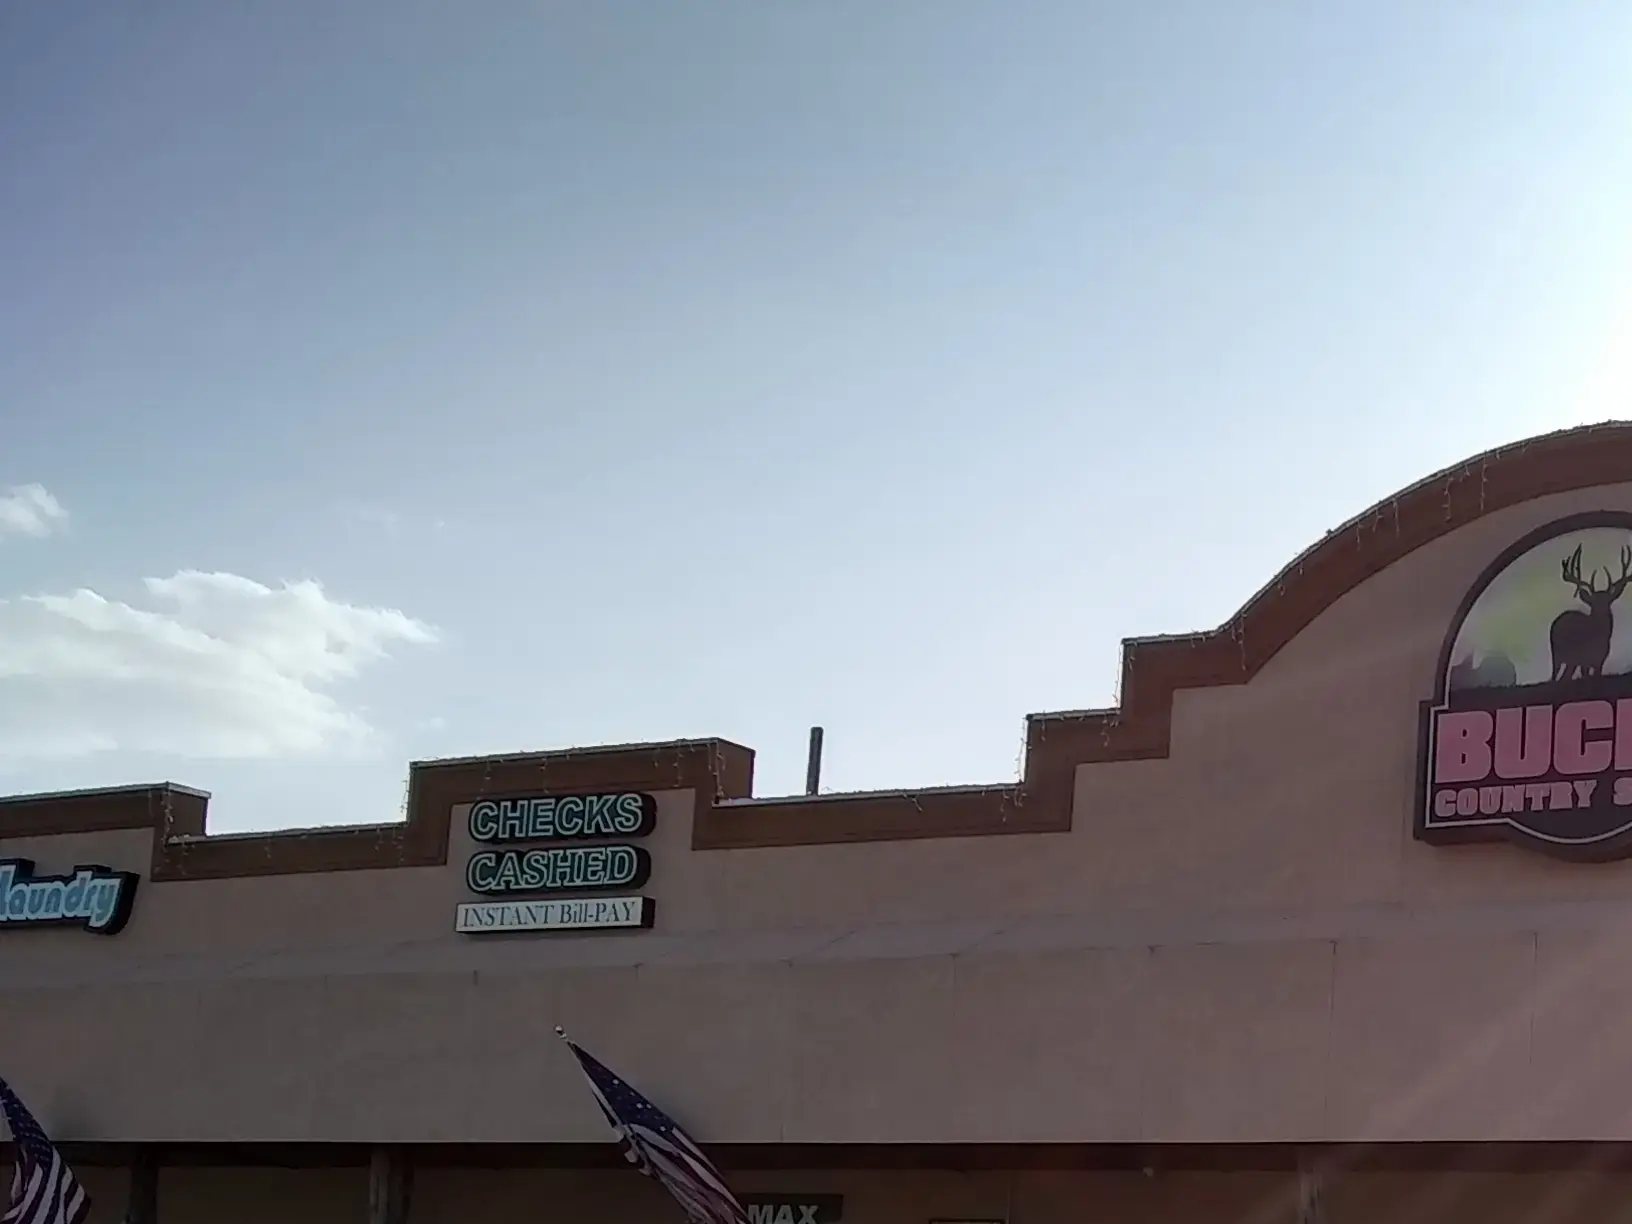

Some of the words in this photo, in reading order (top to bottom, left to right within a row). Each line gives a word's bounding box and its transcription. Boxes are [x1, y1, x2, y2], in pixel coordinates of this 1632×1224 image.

[470, 793, 643, 840] CHECKS
[1433, 780, 1598, 817] COUNTRY
[467, 846, 637, 892] CASHED
[463, 905, 555, 928] INSTANT
